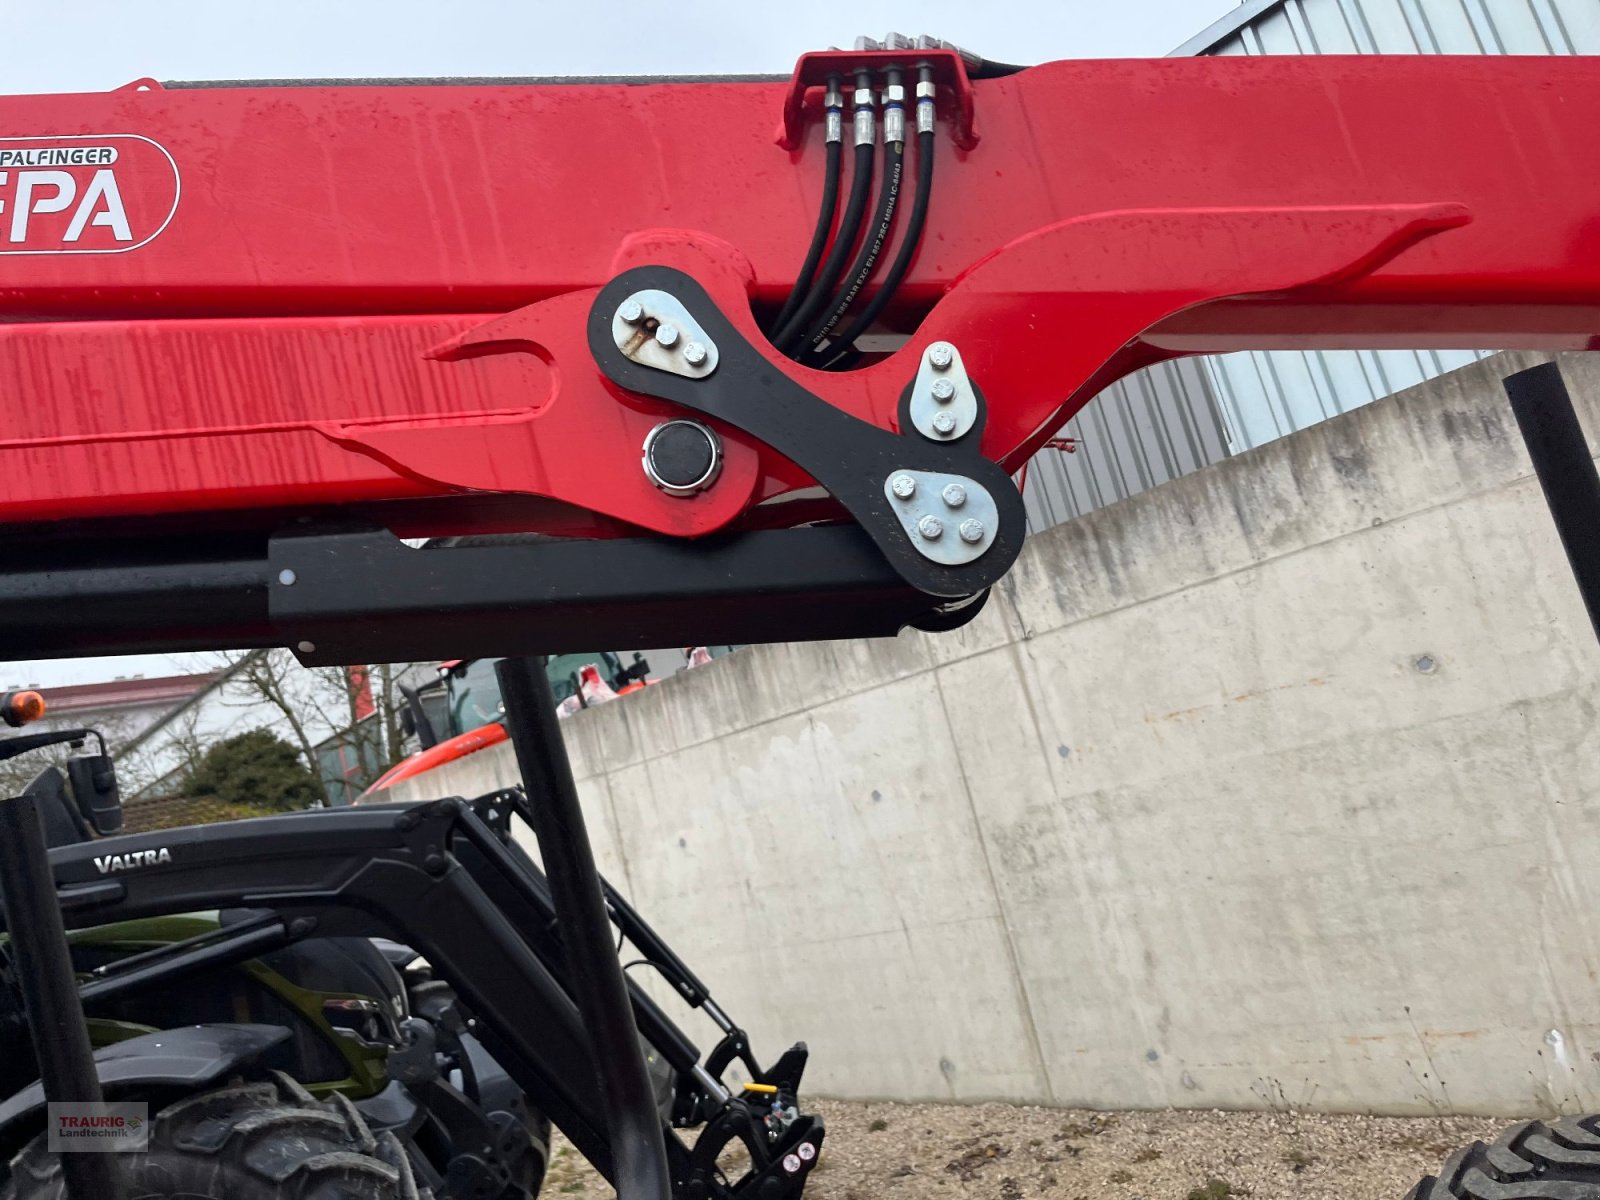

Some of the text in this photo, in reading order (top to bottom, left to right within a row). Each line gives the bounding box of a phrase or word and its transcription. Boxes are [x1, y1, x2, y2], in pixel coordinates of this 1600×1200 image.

[0, 148, 112, 165] PALFINGER
[884, 197, 896, 221] MSHA
[880, 222, 889, 240] 2SC
[866, 255, 875, 267] EN
[856, 268, 870, 285] EXC
[845, 284, 860, 302] BAR
[93, 847, 172, 874] VALTRA
